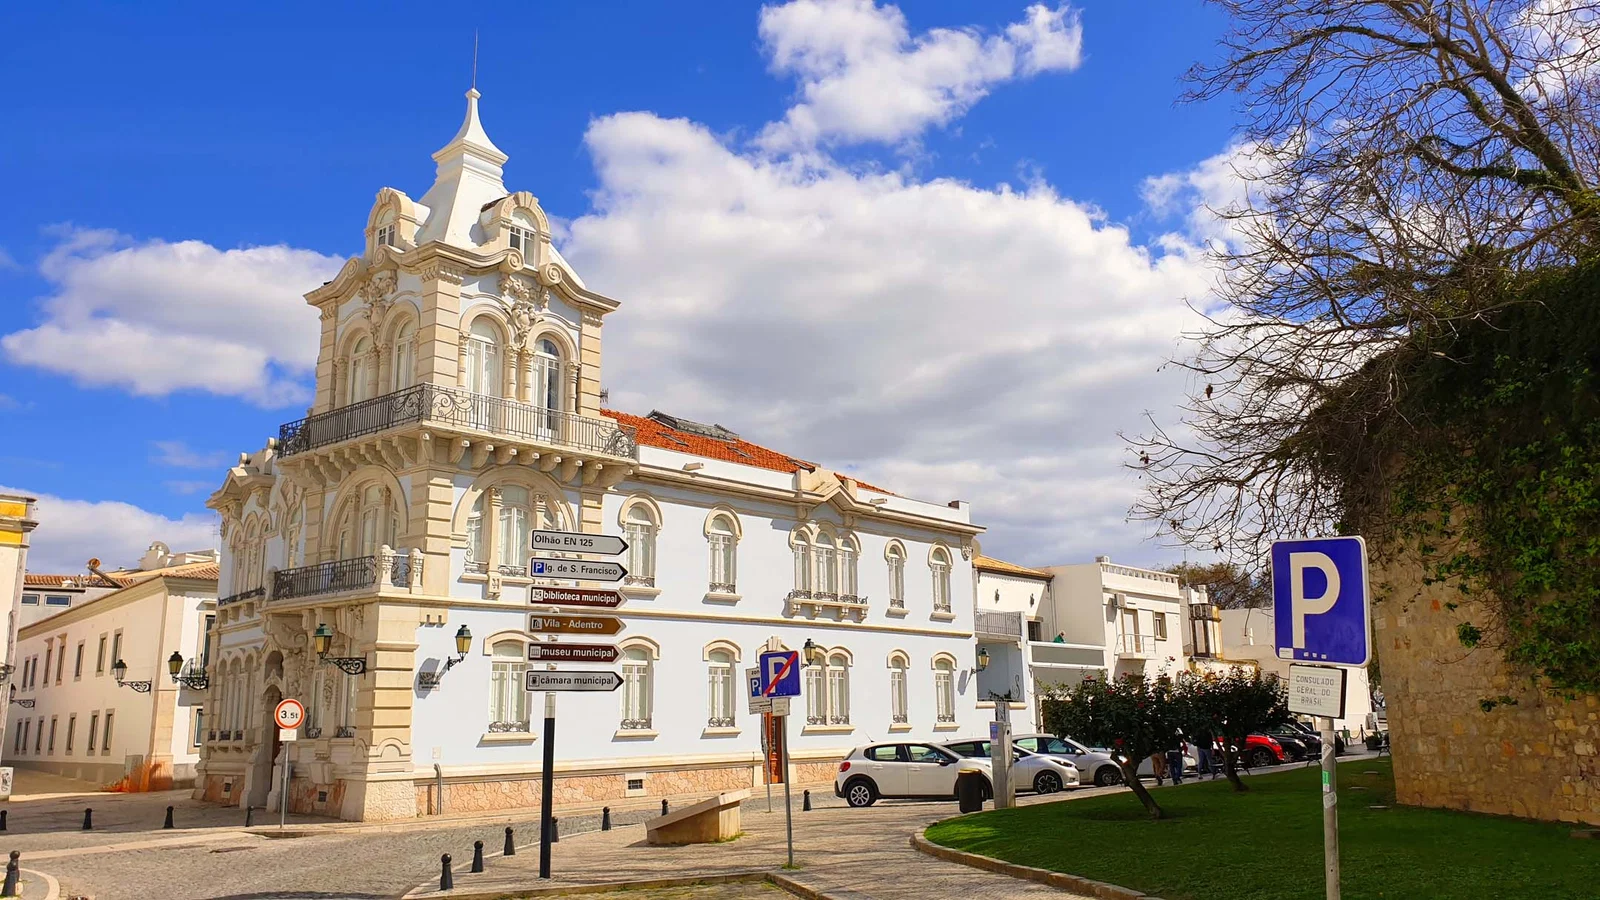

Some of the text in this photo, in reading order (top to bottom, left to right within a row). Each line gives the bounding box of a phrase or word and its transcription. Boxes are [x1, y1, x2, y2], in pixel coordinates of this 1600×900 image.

[534, 534, 593, 547] Olhão EN 125
[535, 562, 542, 572] P
[557, 564, 568, 573] de
[570, 565, 579, 573] S.
[581, 565, 618, 576] Francisco
[543, 590, 617, 604] biblioteca municipal
[1289, 551, 1341, 649] P
[543, 619, 560, 628] Vila
[568, 619, 603, 629] Adentro
[541, 648, 614, 659] museu municipal
[768, 656, 791, 693] P
[1295, 675, 1335, 686] CONSULADO
[540, 676, 614, 686] câmara municipal
[751, 679, 759, 692] P
[1296, 686, 1331, 696] GERAL DO
[1300, 696, 1322, 706] BRASIL
